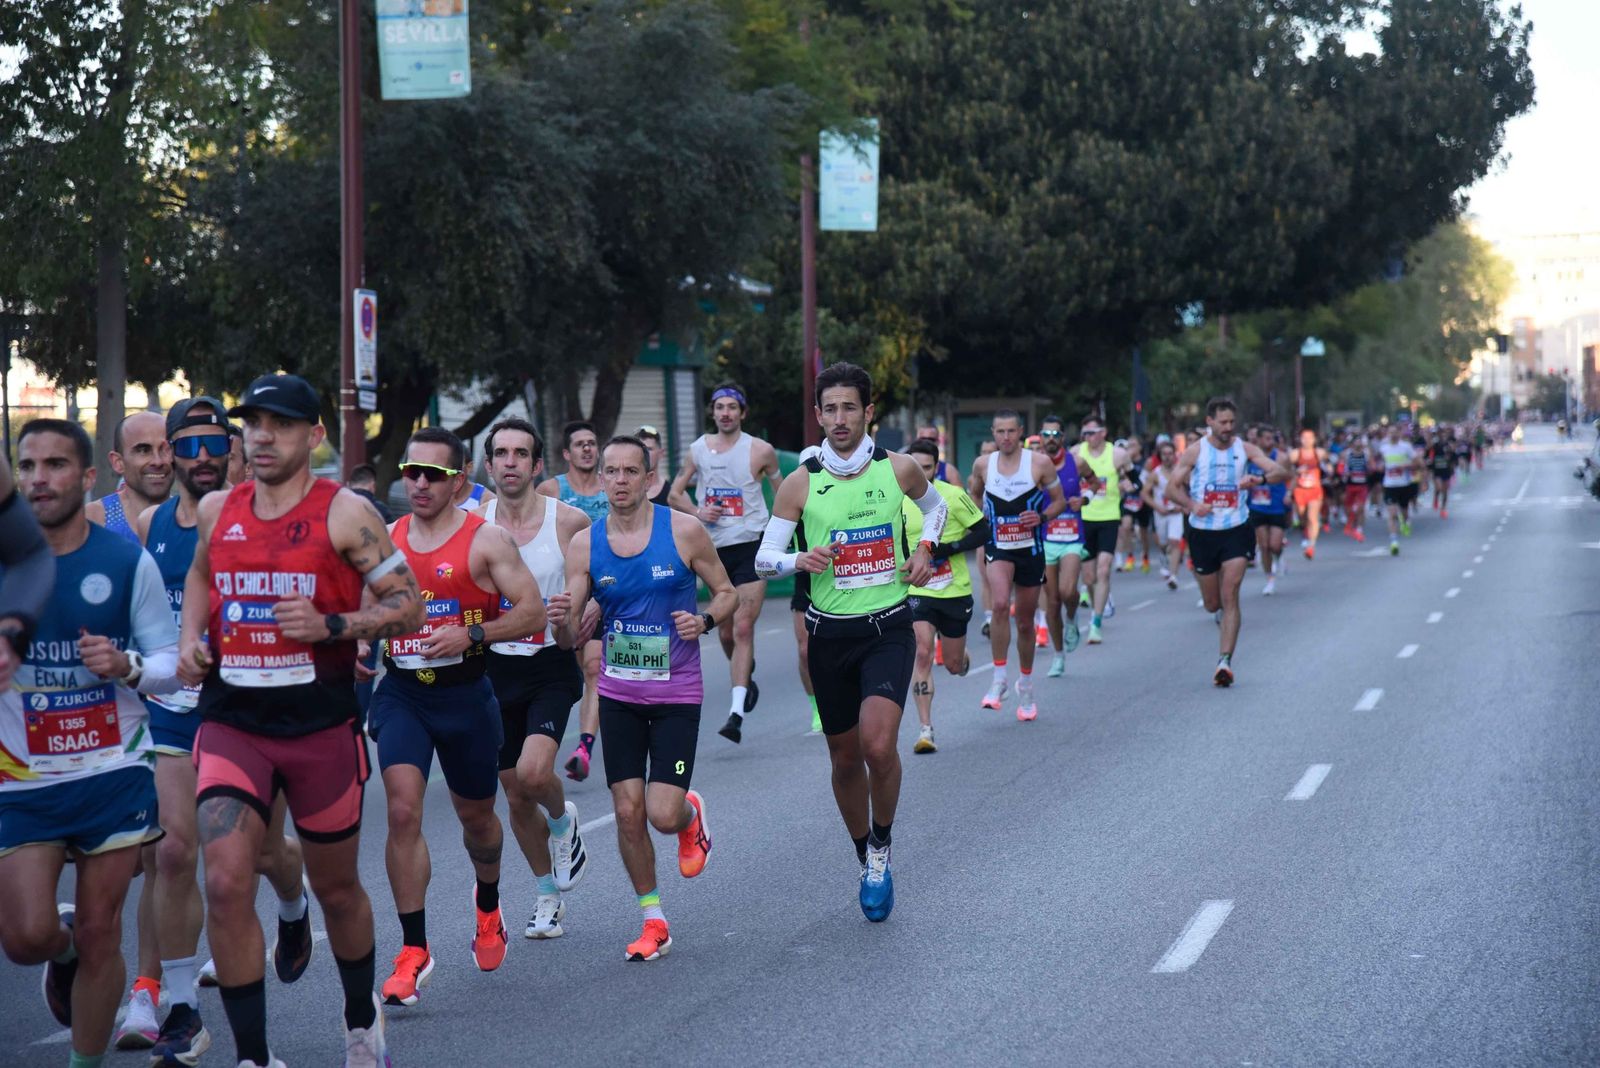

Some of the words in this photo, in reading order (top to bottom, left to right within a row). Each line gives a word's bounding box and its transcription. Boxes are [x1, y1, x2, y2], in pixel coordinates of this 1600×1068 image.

[384, 23, 465, 43] SEVILLA
[851, 528, 887, 540] ZURICH
[998, 531, 1032, 542] MATTHIEU
[857, 548, 872, 558] 913
[834, 558, 895, 576] KIPCHHJOSE
[425, 603, 450, 614] RICH
[625, 624, 662, 634] ZURICH
[250, 632, 276, 644] 1135
[628, 642, 642, 651] 531
[221, 654, 262, 667] ALVARO
[264, 652, 313, 667] MANUEL
[611, 652, 639, 667] JEAN
[643, 655, 663, 667] PHI
[914, 681, 929, 696] 42
[54, 689, 105, 707] ZURICH
[58, 717, 86, 730] 1355
[48, 730, 100, 752] ISAAC
